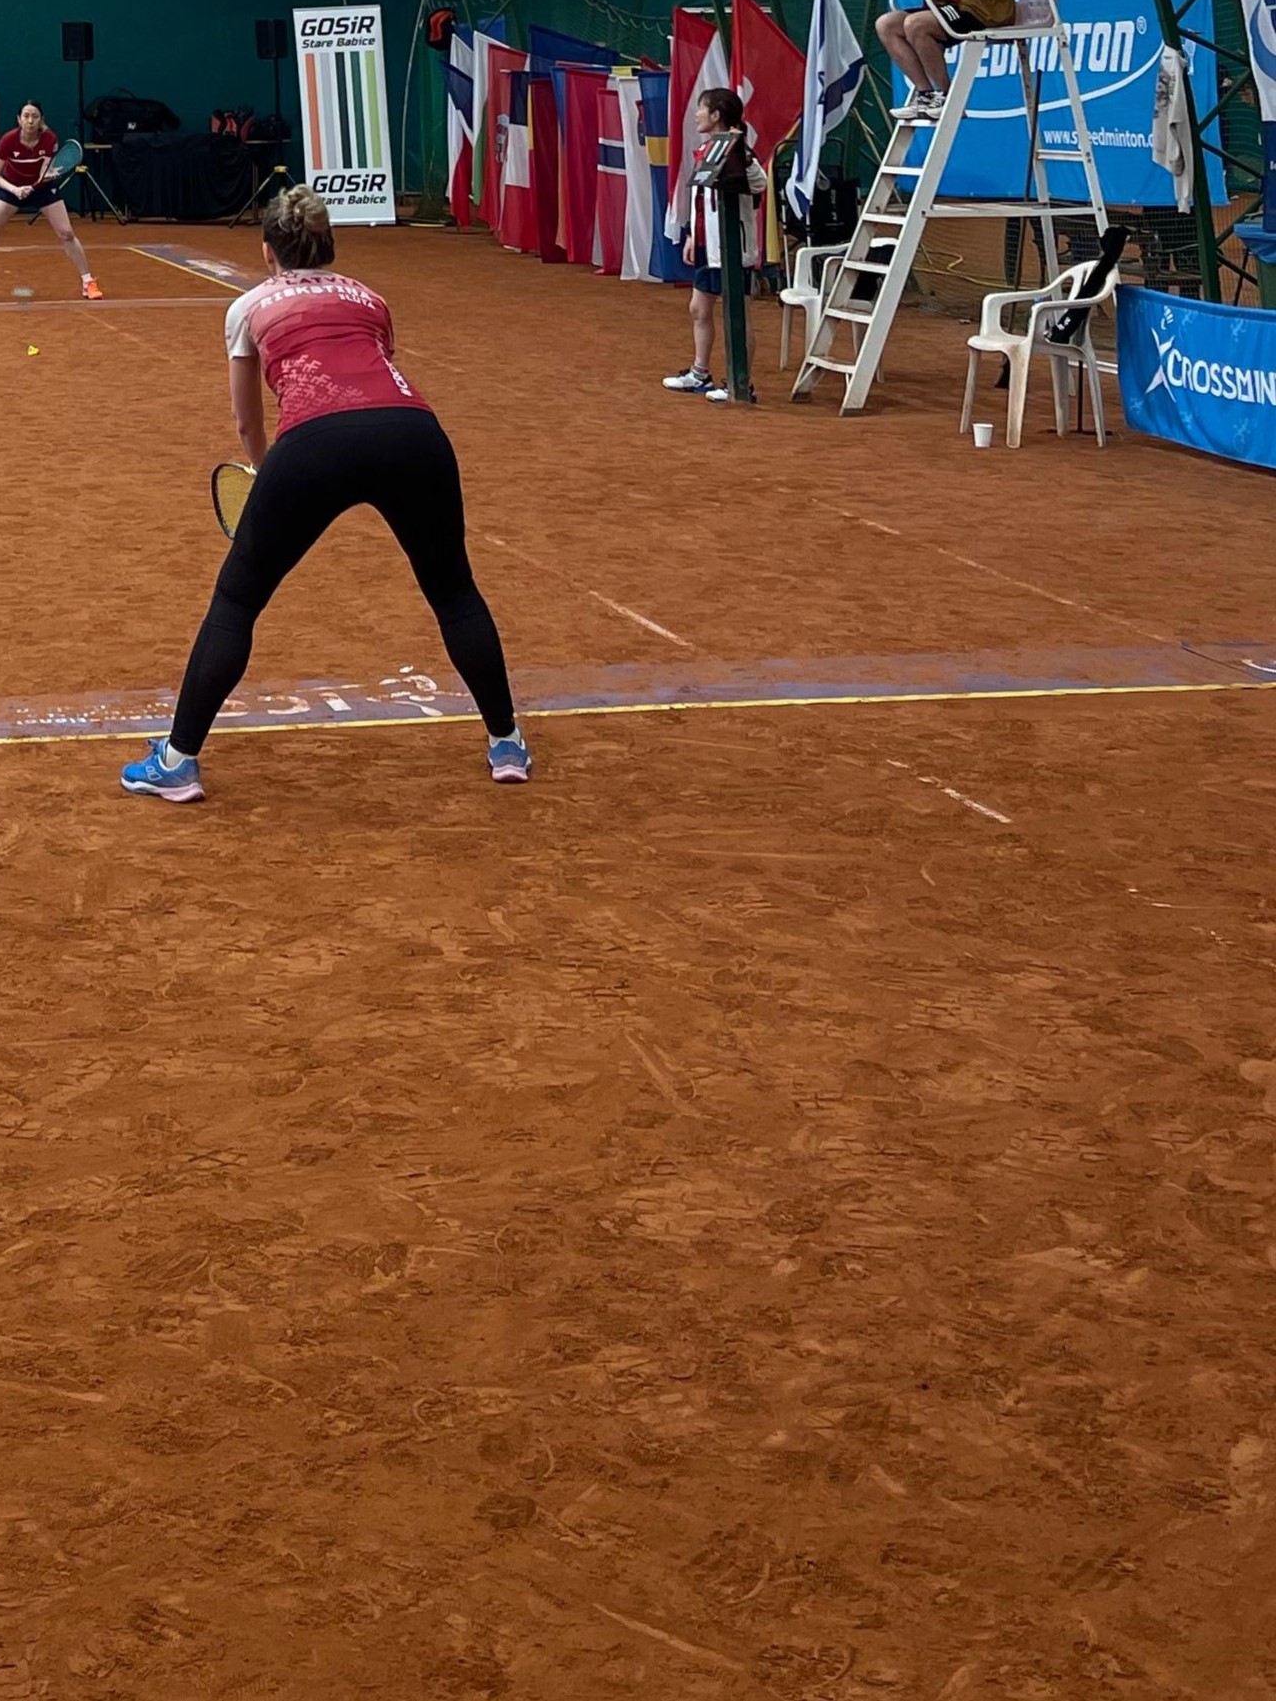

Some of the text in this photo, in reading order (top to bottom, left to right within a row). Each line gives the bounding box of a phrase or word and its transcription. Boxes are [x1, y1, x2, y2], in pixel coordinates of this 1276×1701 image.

[300, 16, 376, 36] GOSiR
[301, 36, 376, 49] Stare Babice
[312, 173, 387, 193] GOSiR
[347, 194, 387, 205] Babice
[1167, 348, 1276, 406] CROSSMIN
